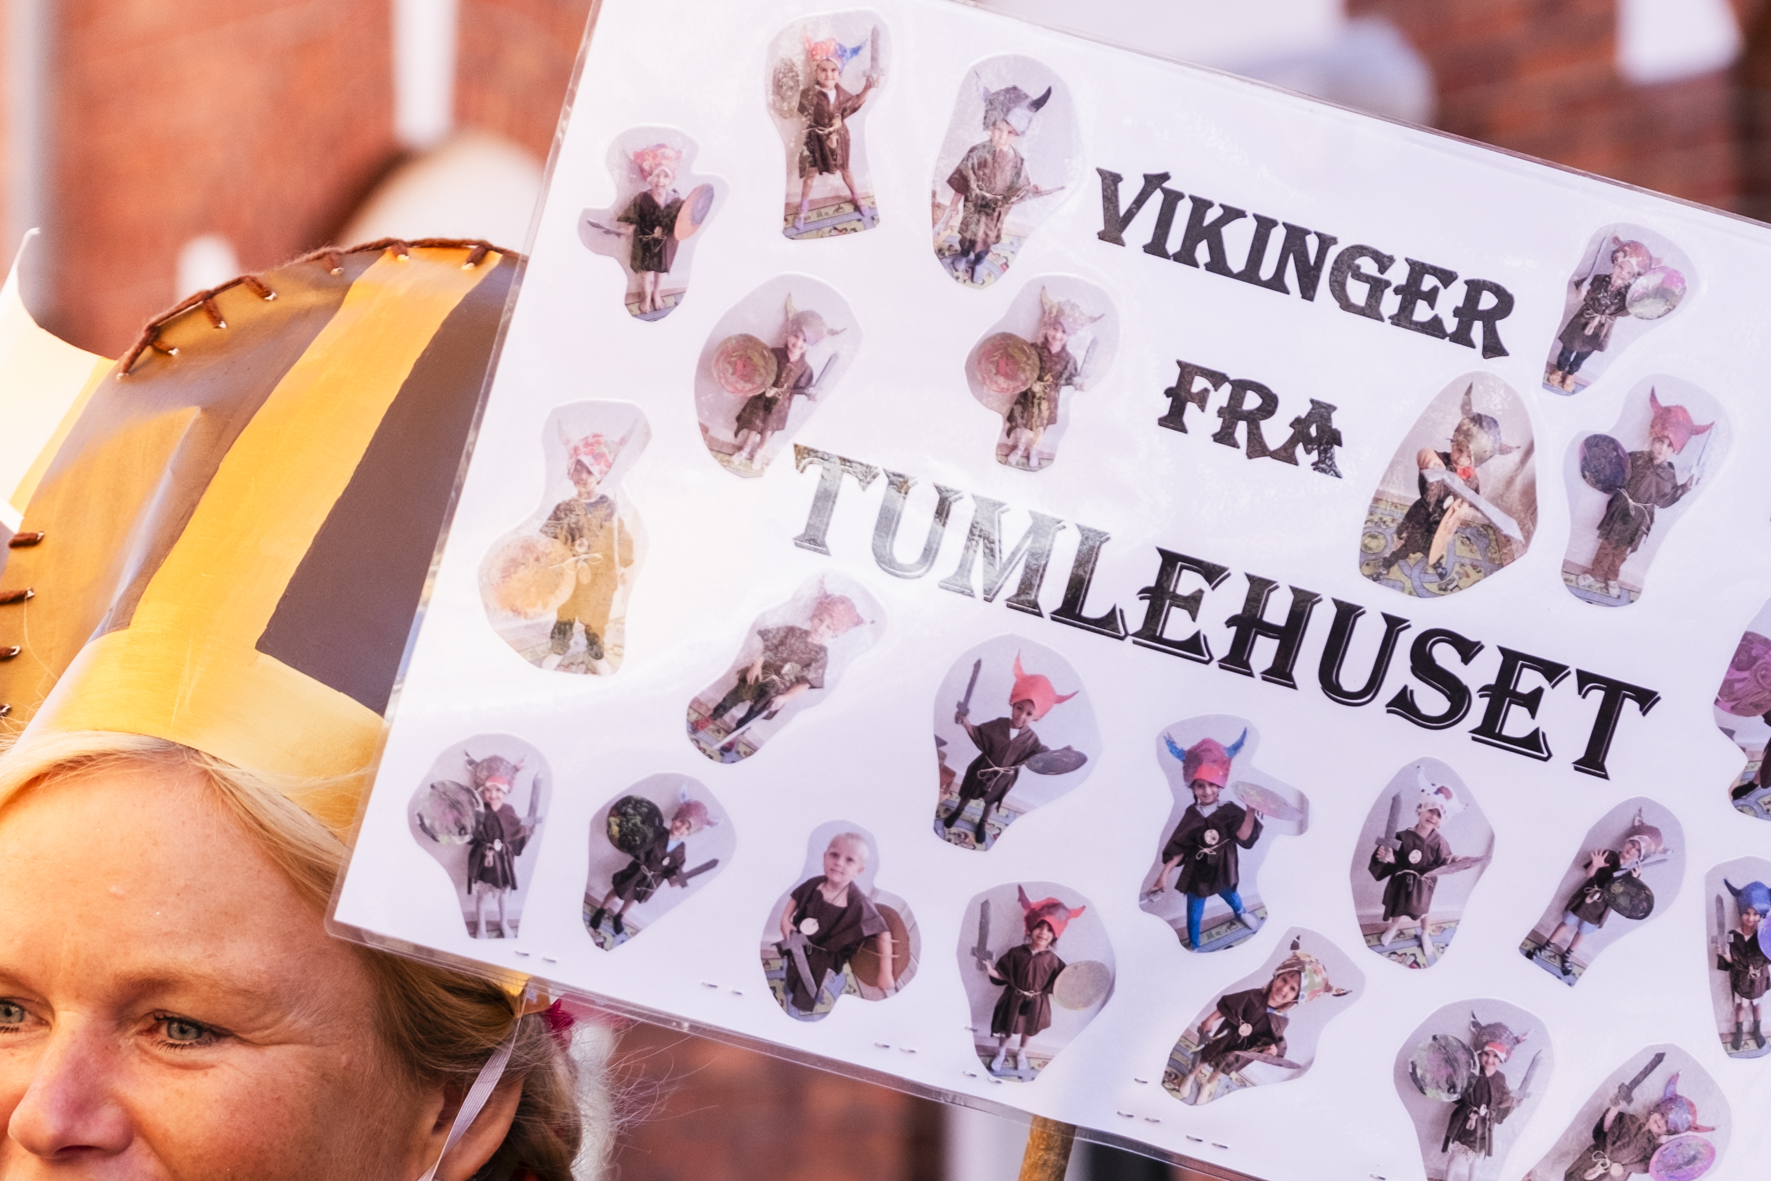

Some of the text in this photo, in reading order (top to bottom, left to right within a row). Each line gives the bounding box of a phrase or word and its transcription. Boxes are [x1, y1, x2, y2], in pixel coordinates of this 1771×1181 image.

[1095, 167, 1515, 358] VIKINGER
[1158, 360, 1344, 479] FRA
[793, 442, 1661, 780] TUMLEHUSET
